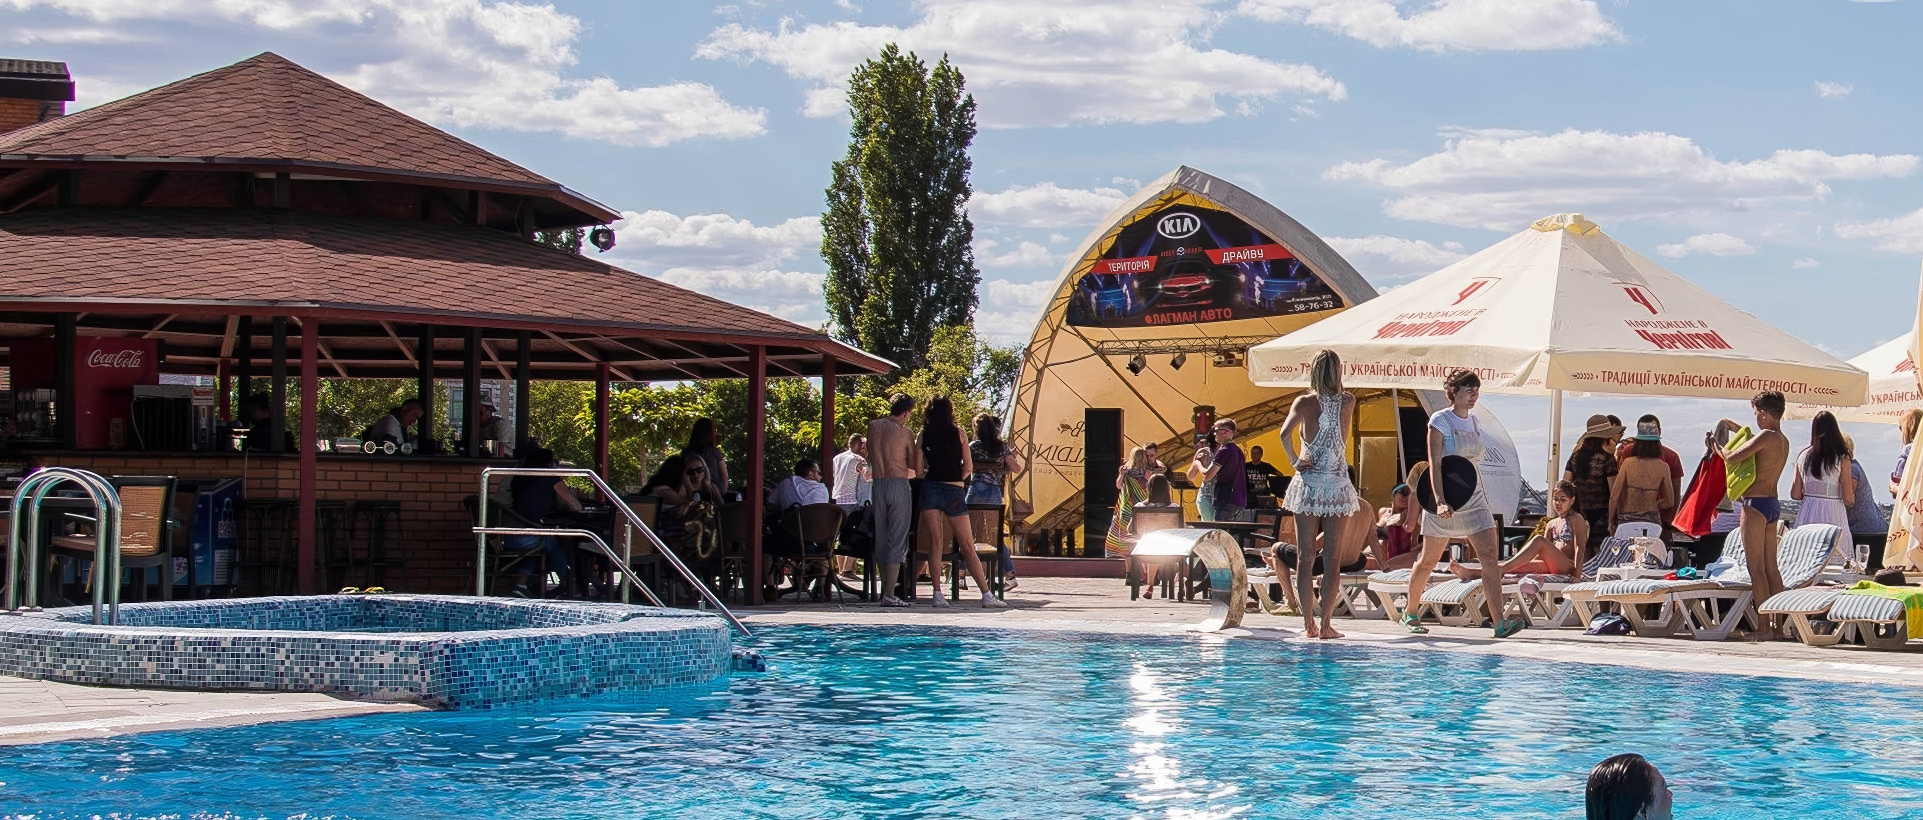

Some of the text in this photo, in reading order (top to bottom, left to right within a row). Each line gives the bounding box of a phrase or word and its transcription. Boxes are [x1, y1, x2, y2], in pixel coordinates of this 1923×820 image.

[1164, 217, 1194, 233] KIA
[1222, 248, 1264, 263] ДРАЙВУ
[1107, 260, 1150, 272] ТЕРИТОРІЯ
[1294, 300, 1334, 311] 58-76-32
[1200, 307, 1232, 321] АВТО
[88, 349, 144, 368] Coca-Cola
[1350, 361, 1417, 377] УКРАЇНСЬКОЇ
[1420, 364, 1496, 381] МАЙСТОСТІ
[1601, 370, 1808, 394] ТРАДИЦІЇ УКРАЇНСЬКОЇ МАЙСТЕРНОСТІ
